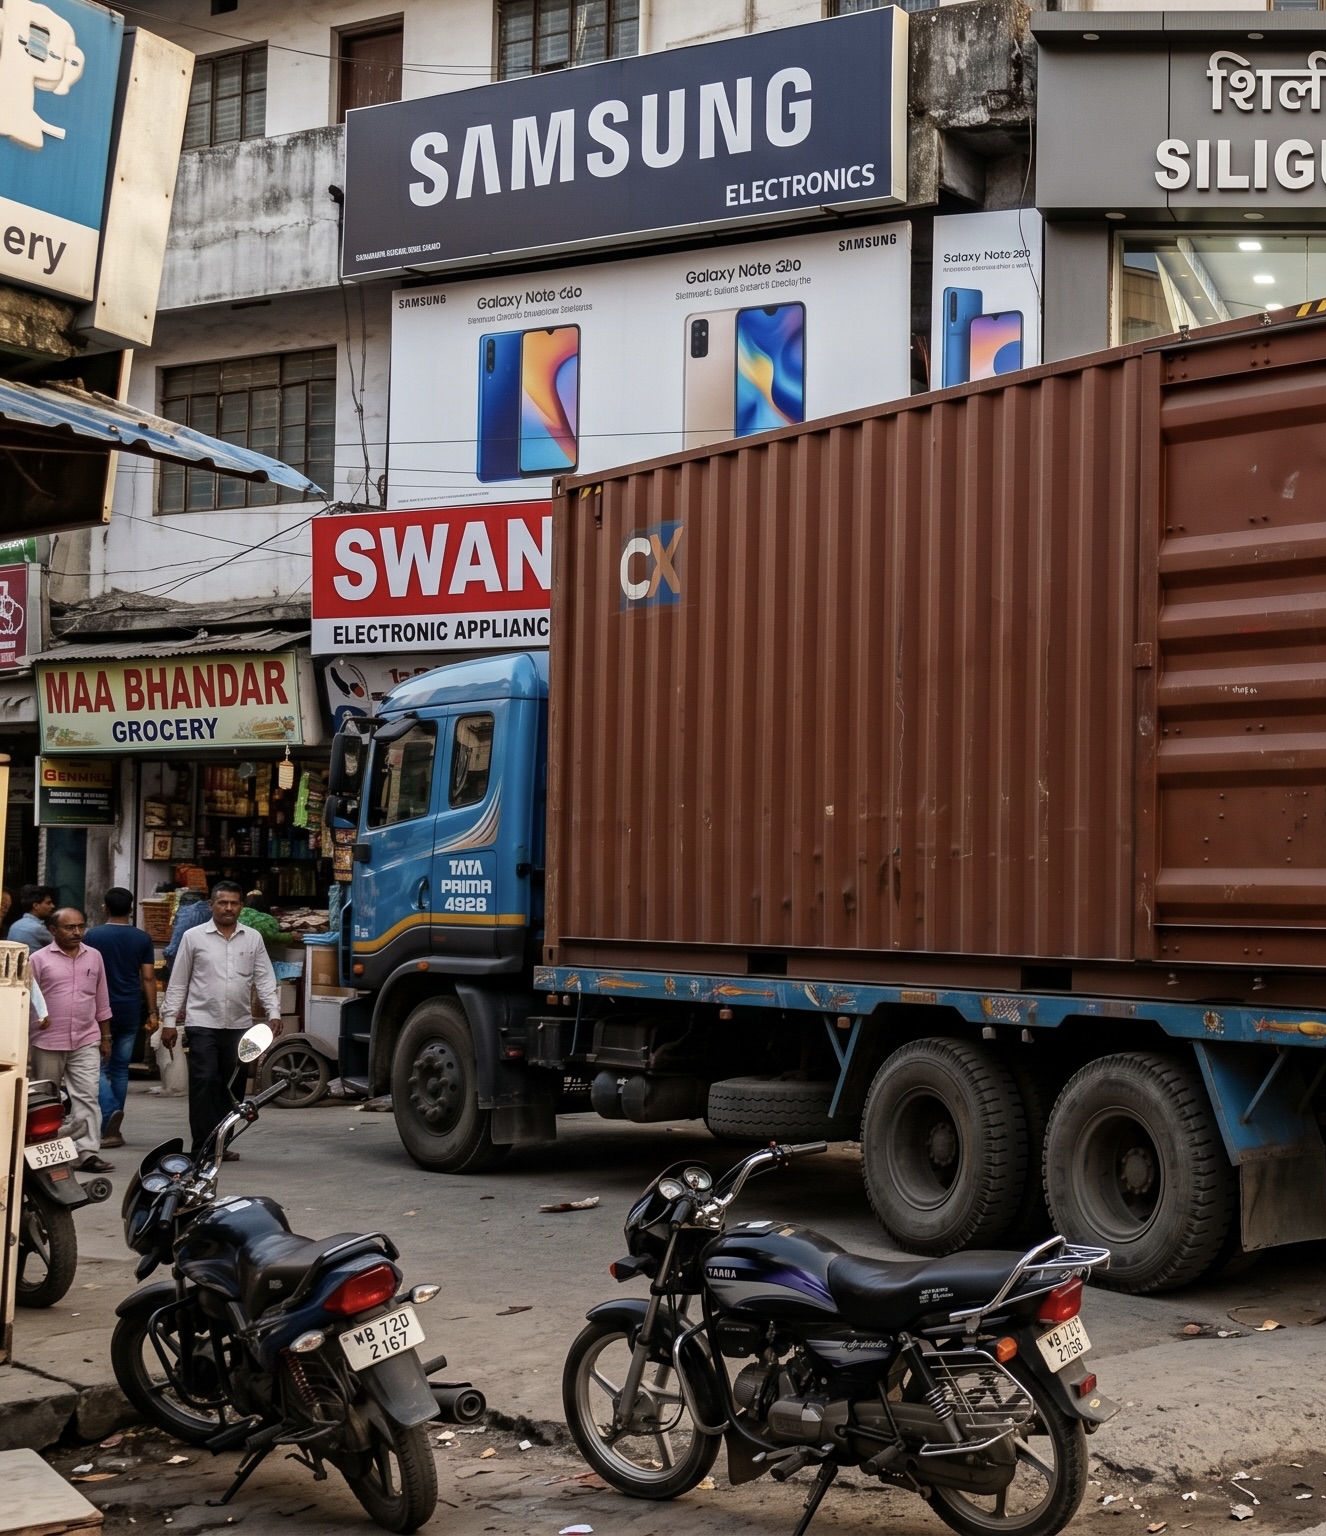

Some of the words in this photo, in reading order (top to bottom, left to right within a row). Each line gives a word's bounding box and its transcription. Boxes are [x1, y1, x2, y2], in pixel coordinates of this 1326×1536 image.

[408, 66, 812, 208] SAMSUNG
[725, 163, 875, 208] ELECTRONICS
[3, 225, 68, 276] ery
[838, 233, 897, 252] SAMSUNG
[686, 267, 735, 285] Galaxy
[738, 262, 772, 278] Note
[477, 294, 523, 310] Galaxy
[332, 515, 553, 601] SWAN
[620, 526, 684, 600] CX
[333, 621, 448, 645] ELECTRONIC
[453, 616, 549, 640] APPLIANC
[45, 671, 116, 715] MAA
[124, 660, 290, 713] BHANDAR
[111, 717, 220, 744] GROCERY
[448, 859, 484, 876] TATA
[441, 879, 492, 894] PRIMA
[353, 1327, 376, 1346] WB
[370, 1330, 407, 1361] 2167
[1046, 1332, 1062, 1349] WB
